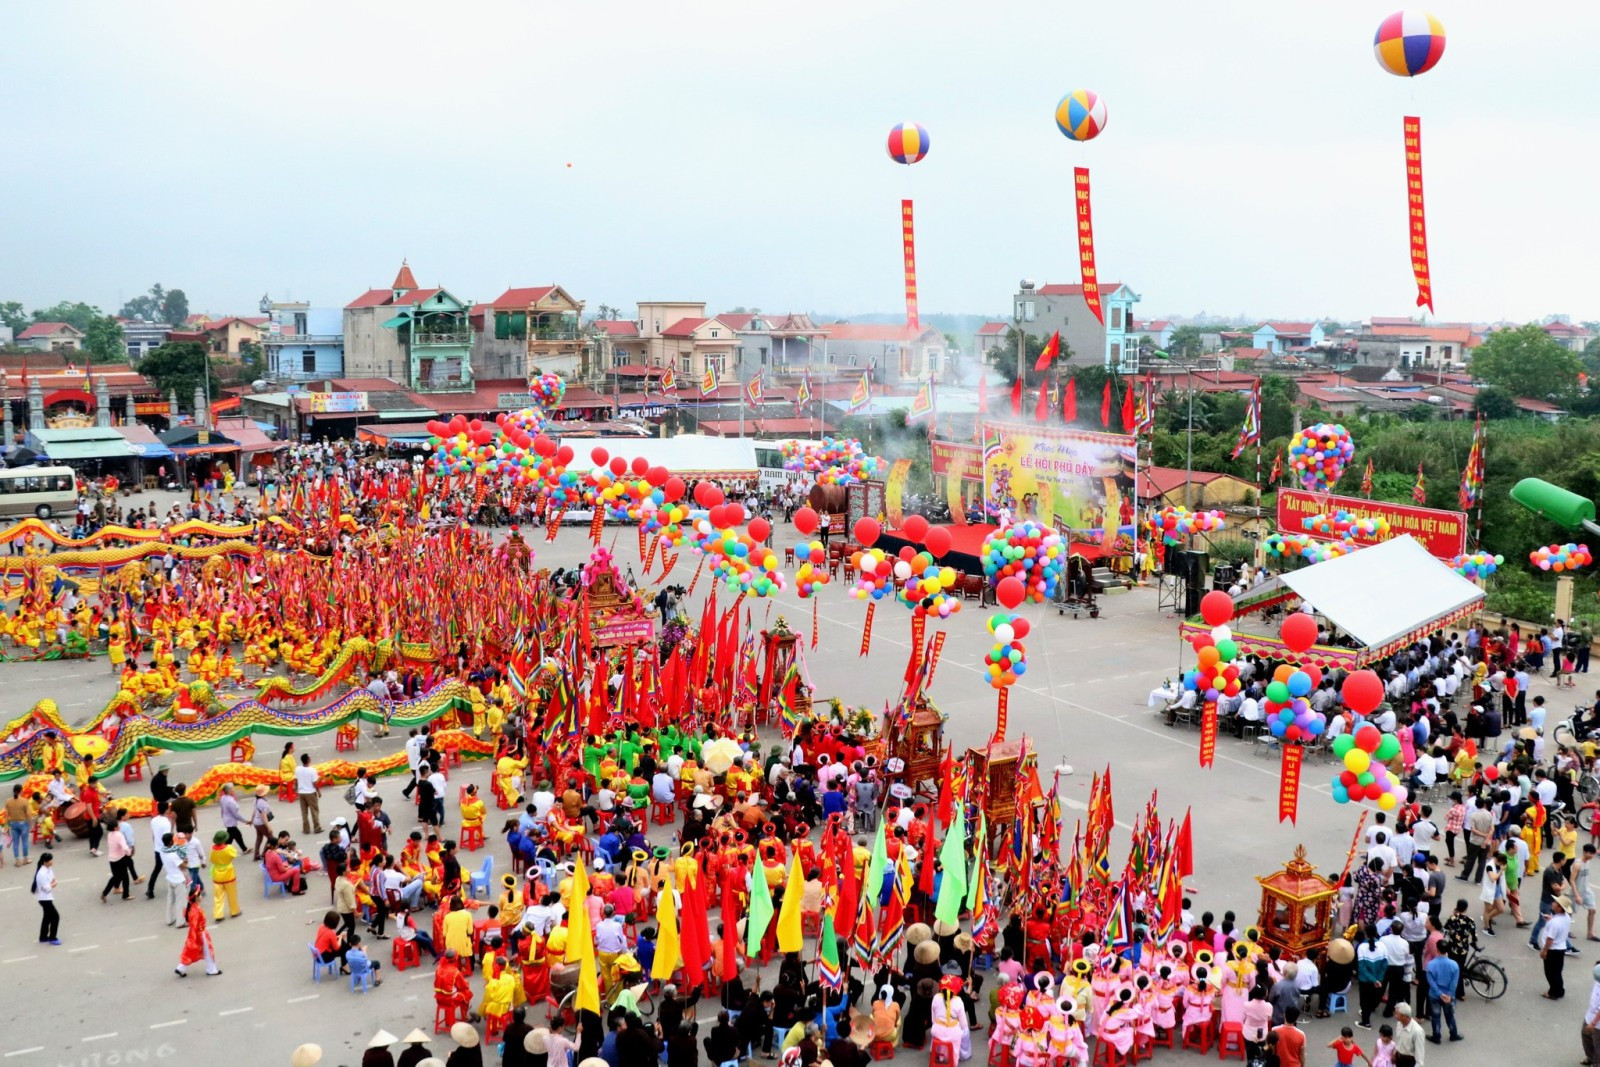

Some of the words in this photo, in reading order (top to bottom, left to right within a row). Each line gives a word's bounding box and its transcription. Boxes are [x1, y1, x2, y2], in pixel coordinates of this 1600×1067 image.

[1020, 453, 1033, 467] LỄ
[1034, 457, 1051, 471] HỘI
[1053, 459, 1073, 473] PHỦ
[1388, 512, 1403, 527] VĂN
[1421, 518, 1437, 533] VIỆT
[1439, 522, 1457, 535] NAM
